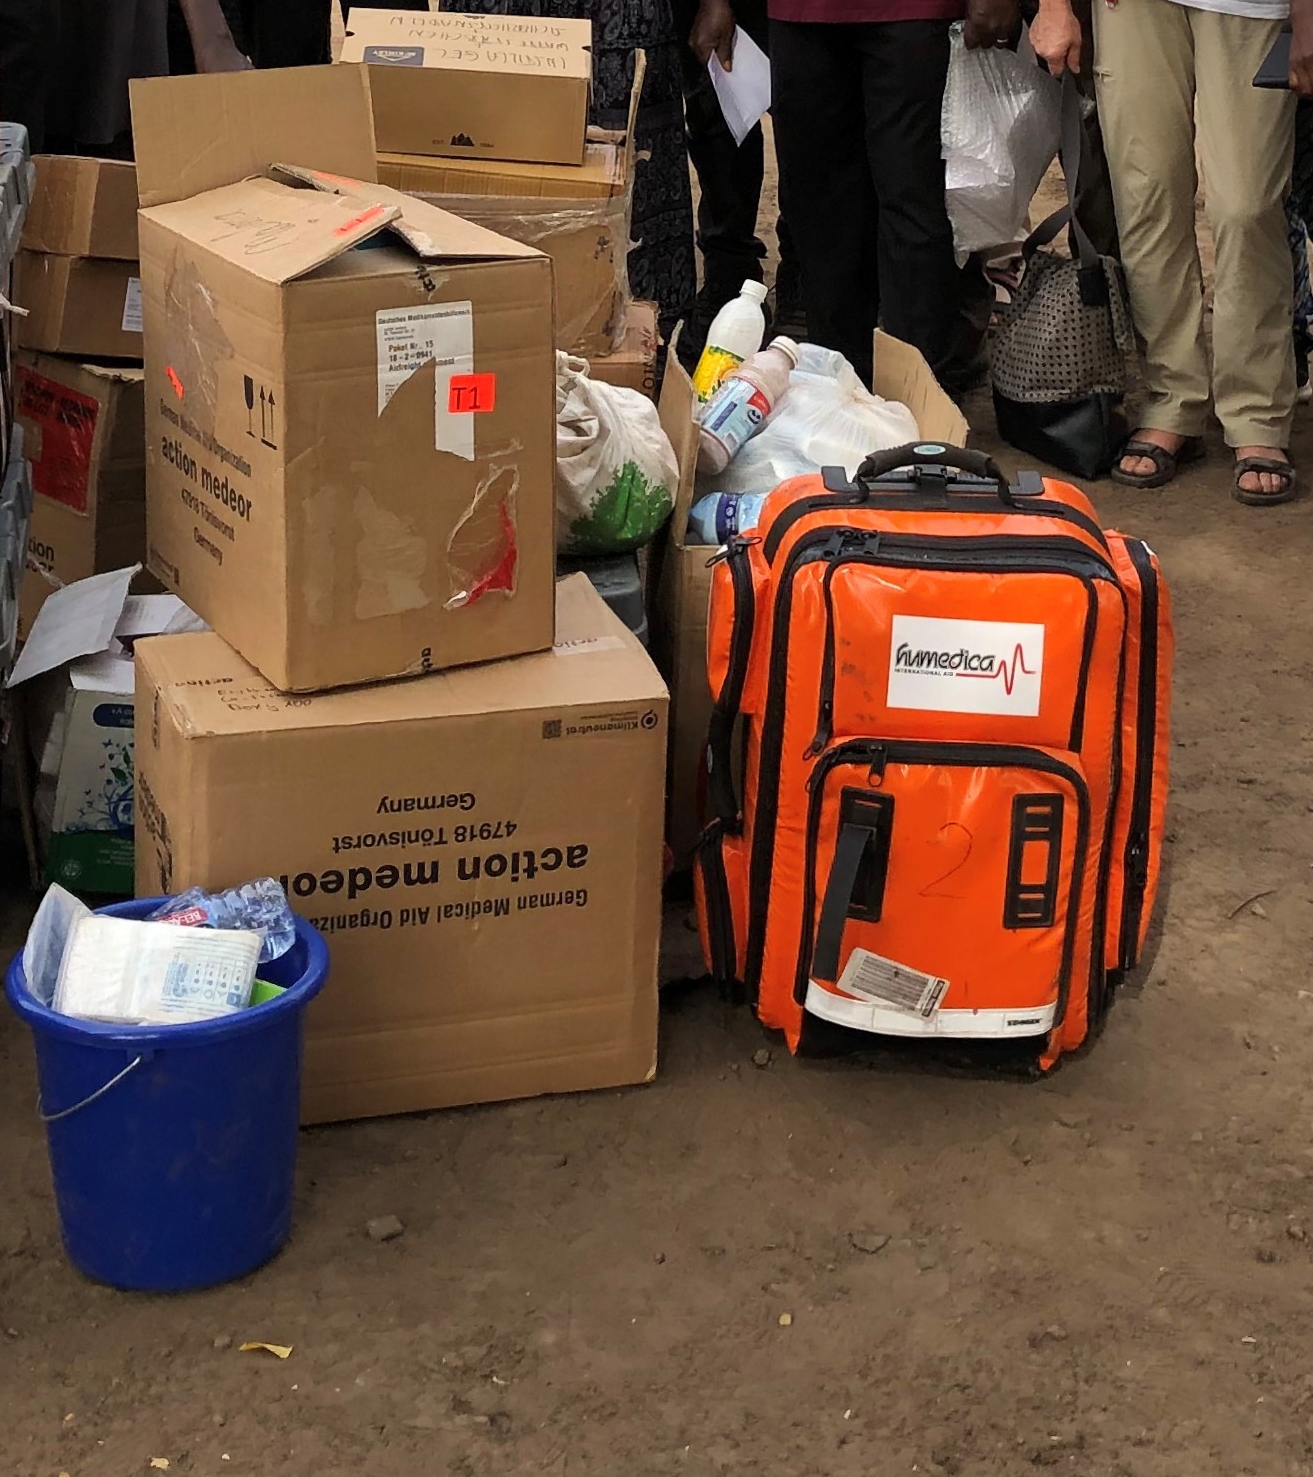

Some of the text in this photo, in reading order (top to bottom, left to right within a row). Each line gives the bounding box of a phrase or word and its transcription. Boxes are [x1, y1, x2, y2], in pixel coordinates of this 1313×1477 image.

[389, 342, 409, 353] Paket
[452, 386, 481, 411] T1
[161, 435, 253, 522] action medeor
[895, 642, 996, 673] humedica
[376, 791, 477, 815] Germany
[332, 821, 518, 853] Tönisvorst 47918
[457, 844, 590, 882] action
[918, 822, 974, 900] 2
[395, 907, 430, 927] Aid
[436, 897, 512, 924] Medical
[516, 889, 589, 913] German
